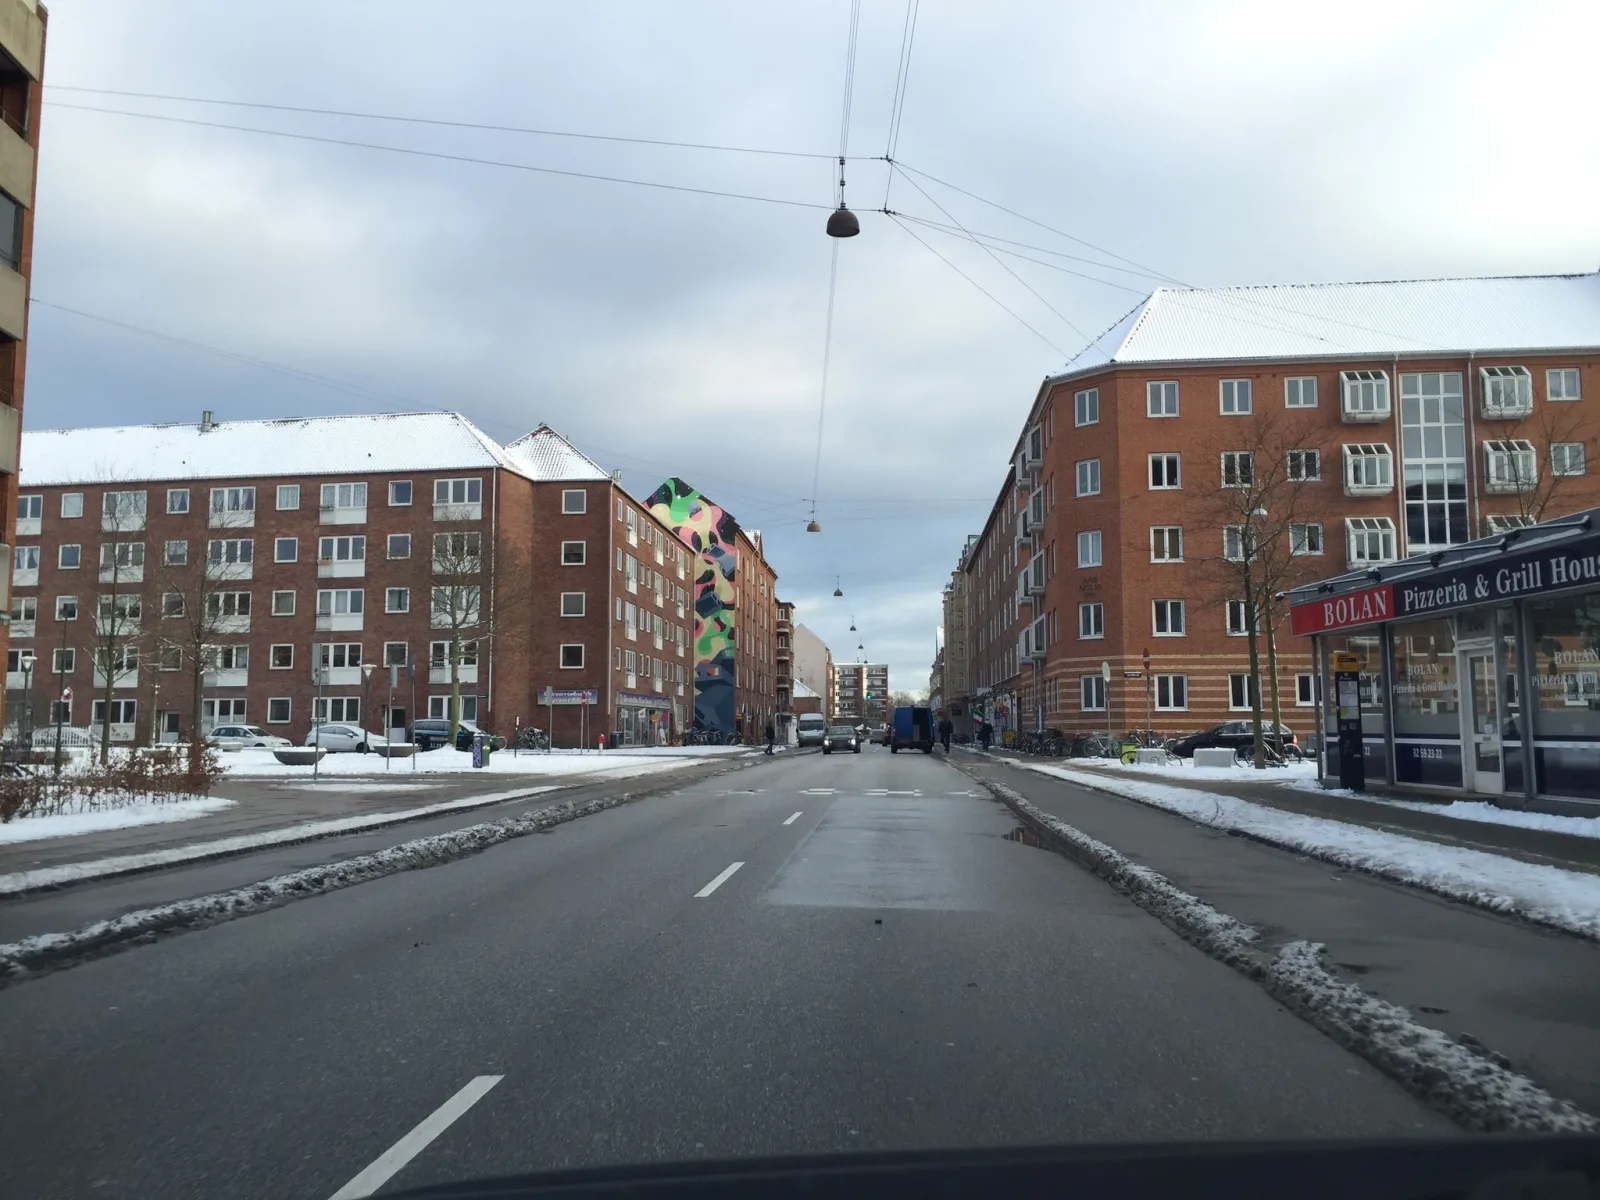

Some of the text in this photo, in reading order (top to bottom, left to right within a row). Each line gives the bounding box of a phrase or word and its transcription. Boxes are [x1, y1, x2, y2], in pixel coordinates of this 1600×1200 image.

[1404, 578, 1468, 612] Pizzeria
[1474, 573, 1490, 599] &
[1496, 561, 1543, 594] Grill
[1324, 591, 1387, 626] BOLAN
[1554, 648, 1600, 665] BOLAN
[1409, 663, 1438, 675] BOLAN
[1422, 683, 1437, 692] Grill
[1412, 748, 1420, 758] 32
[1435, 749, 1443, 759] 22
